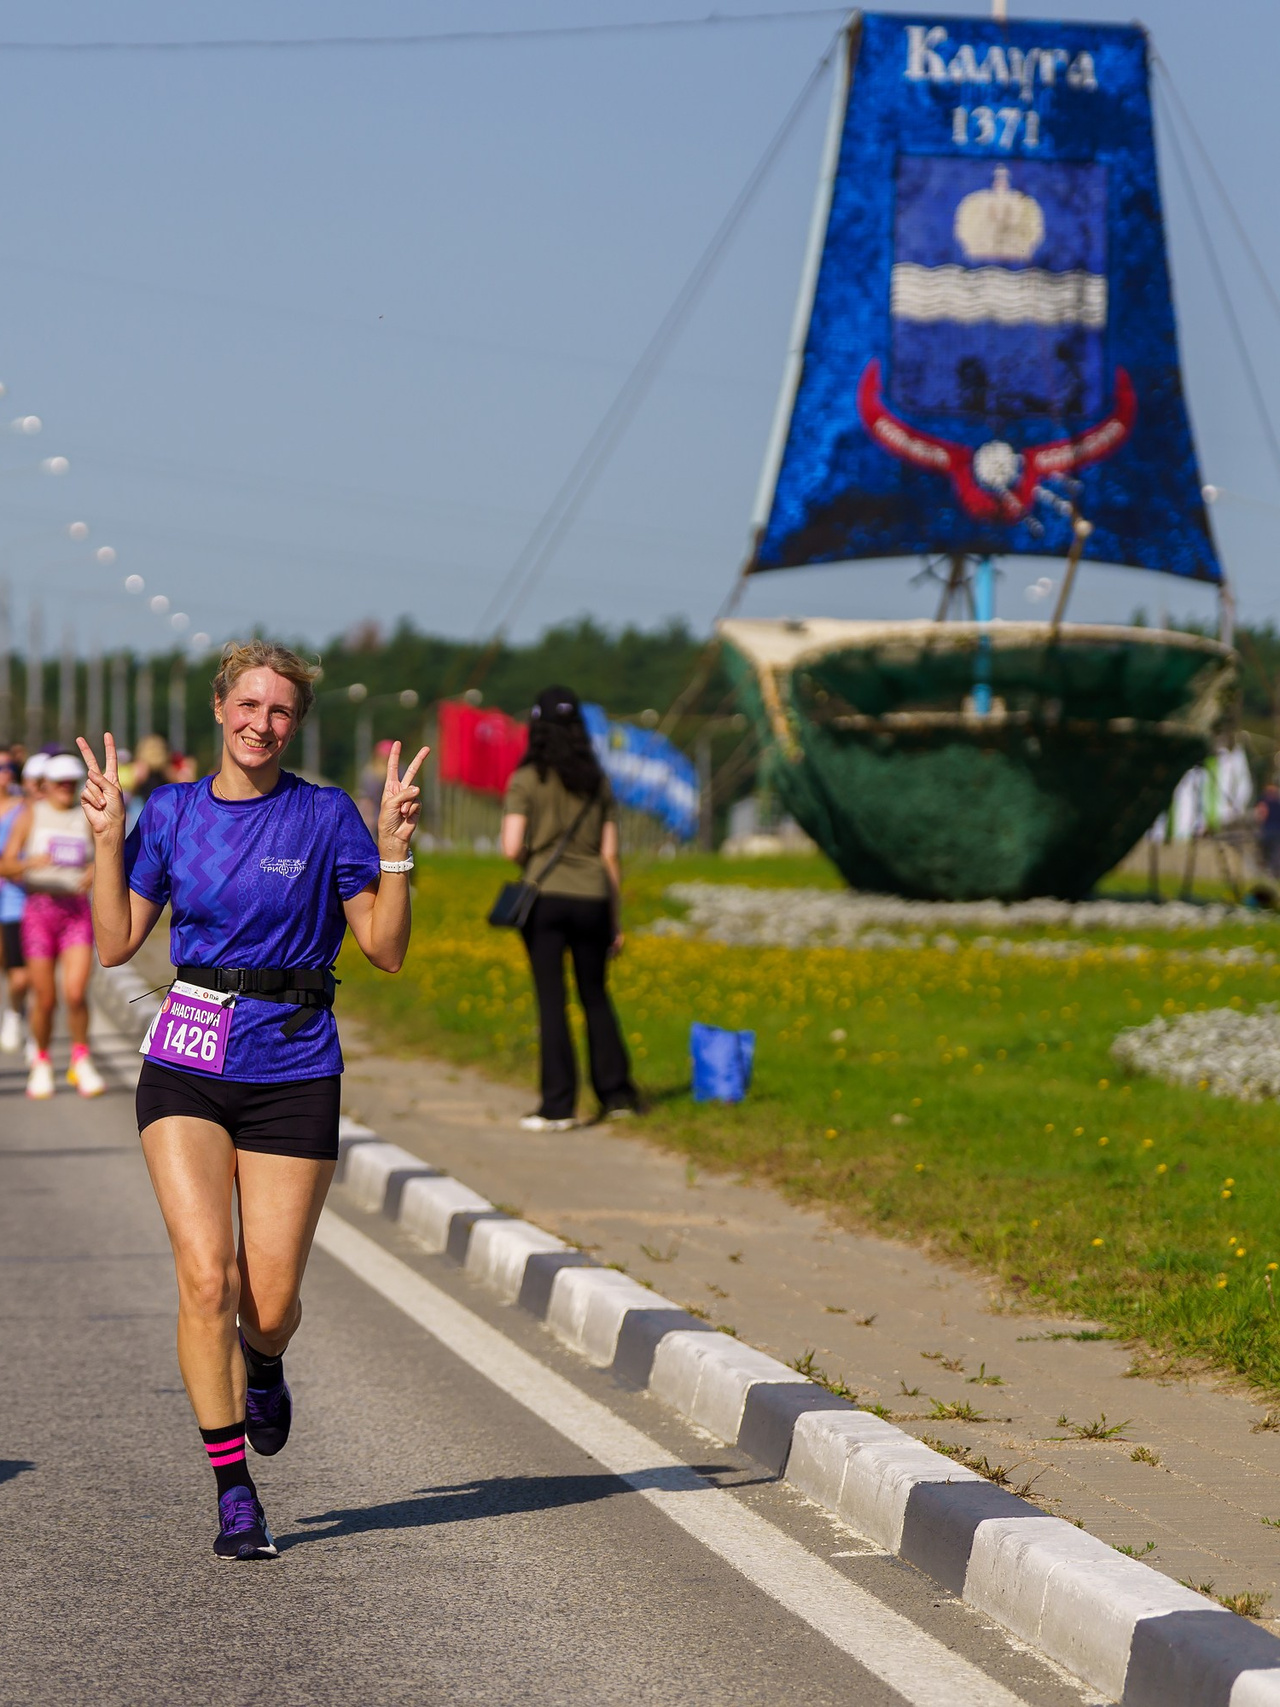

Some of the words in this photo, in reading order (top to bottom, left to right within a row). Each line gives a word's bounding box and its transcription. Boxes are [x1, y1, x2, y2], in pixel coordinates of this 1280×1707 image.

[904, 25, 1098, 102] Калуга
[951, 105, 1040, 149] 1371
[163, 1020, 218, 1062] 1426
